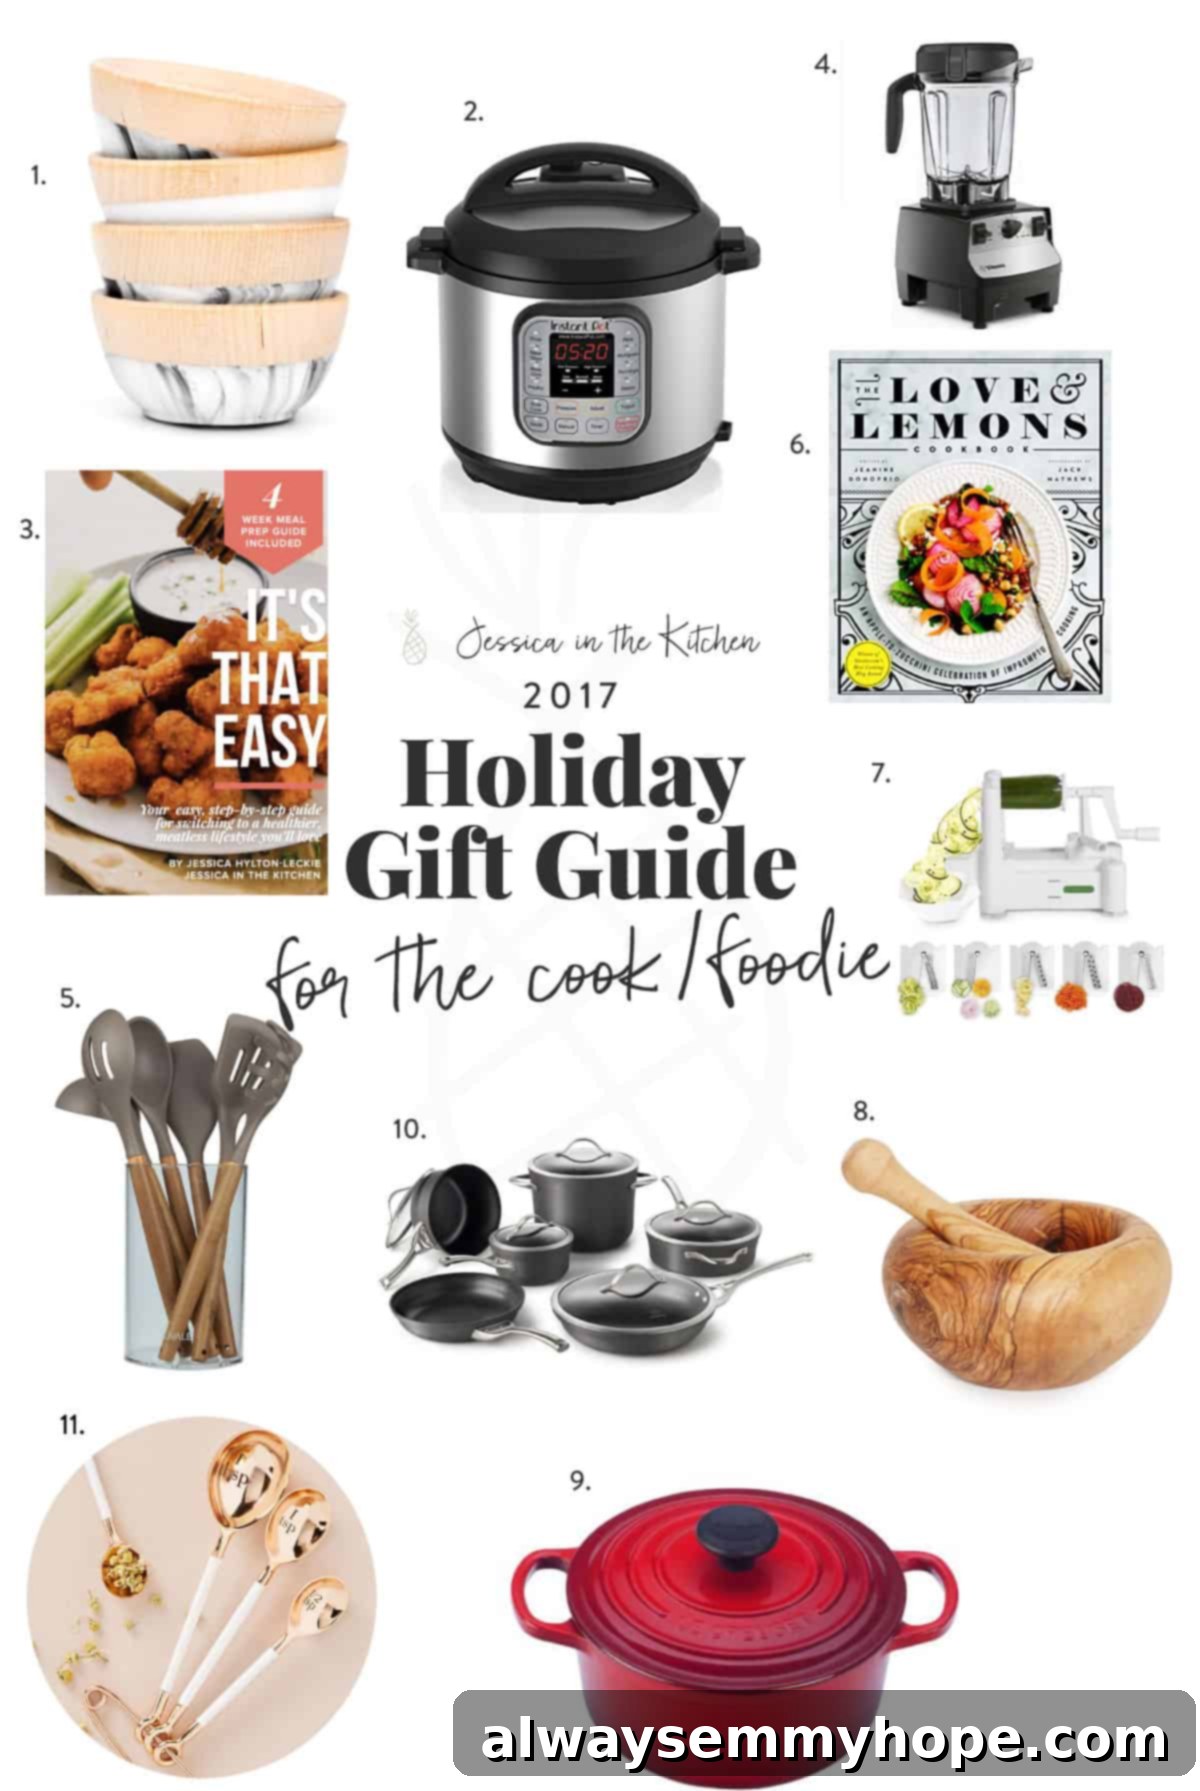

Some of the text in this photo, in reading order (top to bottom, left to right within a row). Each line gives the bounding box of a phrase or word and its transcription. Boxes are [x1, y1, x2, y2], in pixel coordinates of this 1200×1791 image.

[551, 320, 588, 330] Instant
[554, 343, 609, 361] 05:20
[856, 373, 1087, 405] THE LOVE &
[851, 413, 1088, 440] LEMONS
[261, 482, 283, 510] 4
[242, 515, 306, 524] WEEK MEAL
[241, 527, 307, 536] PREP GUIDE
[245, 539, 302, 548] INCLUDED
[247, 588, 326, 642] IT'S
[933, 667, 987, 680] CELEBRATION
[990, 668, 1000, 678] OF
[1003, 646, 1047, 675] IMPROMPTU
[1056, 605, 1079, 636] COOKING
[212, 652, 328, 704] THAT
[214, 713, 327, 768] EASY
[141, 805, 169, 815] Your
[288, 804, 322, 817] guide
[155, 817, 174, 830] for
[177, 817, 234, 830] switching
[237, 819, 250, 829] to
[252, 821, 260, 829] a
[155, 831, 207, 842] meatless
[210, 831, 257, 844] lifestyle
[169, 859, 321, 868] BY JESSICA HYLTON-LECKIE
[184, 871, 321, 880] JESSICA IN THE KITCHEN
